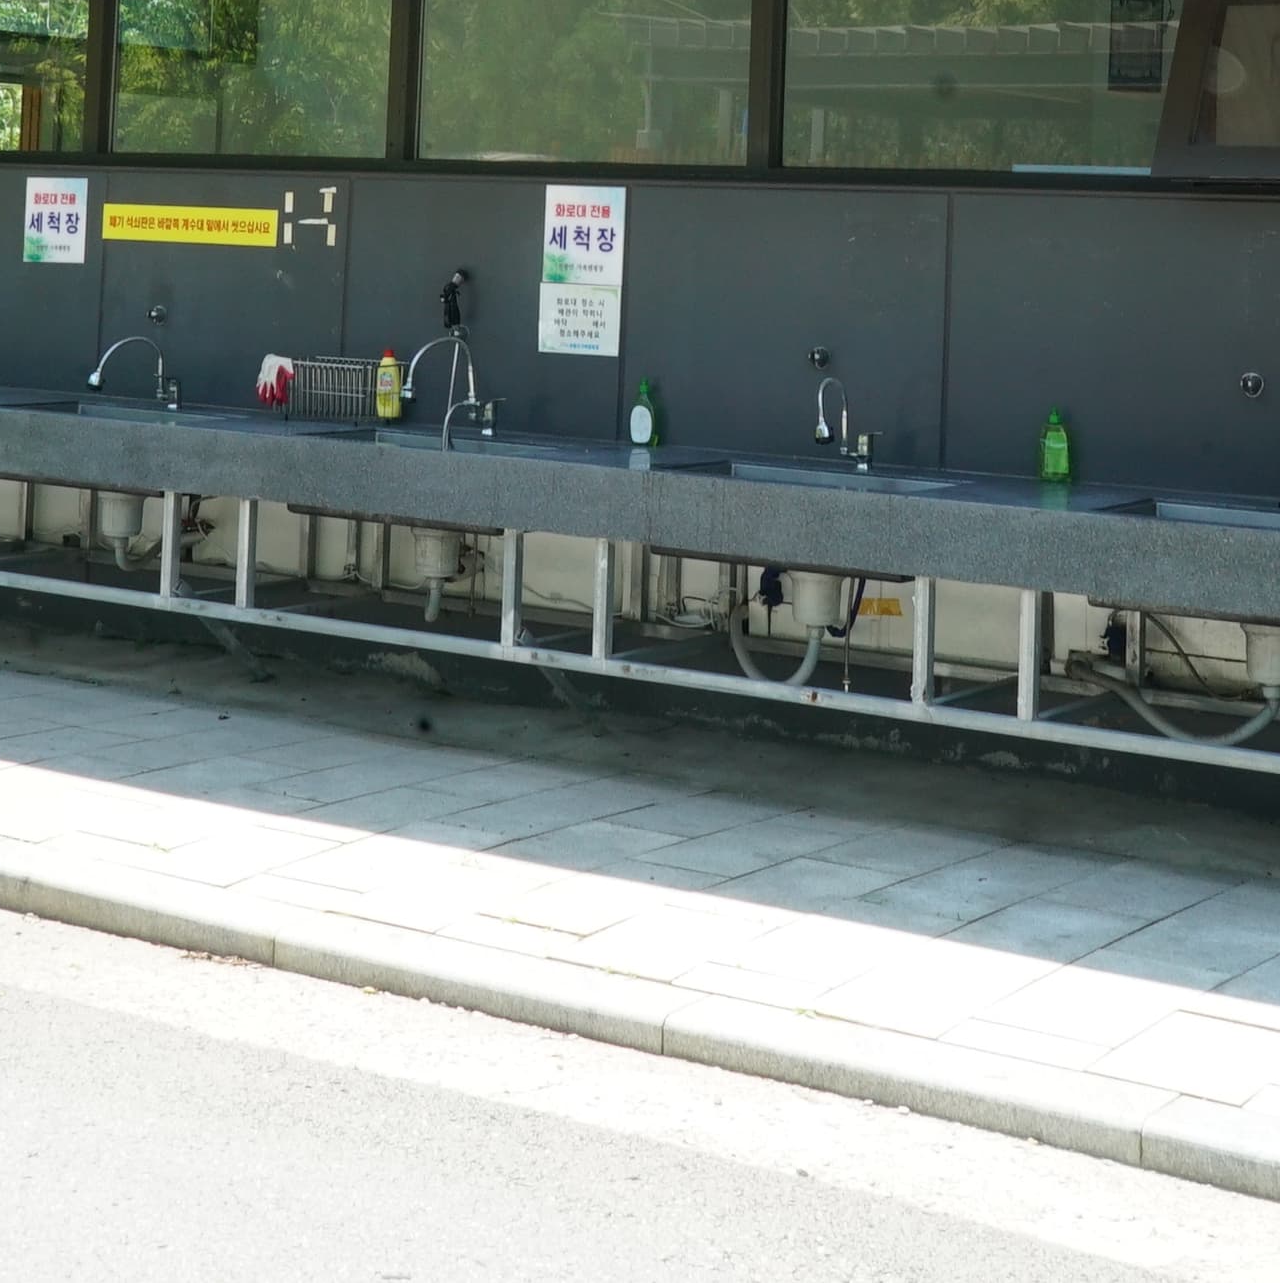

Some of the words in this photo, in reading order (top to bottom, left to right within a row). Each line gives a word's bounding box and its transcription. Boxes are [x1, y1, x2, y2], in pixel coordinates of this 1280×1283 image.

[33, 192, 58, 205] 화로대
[555, 203, 587, 218] 화로대
[590, 205, 611, 219] 전용
